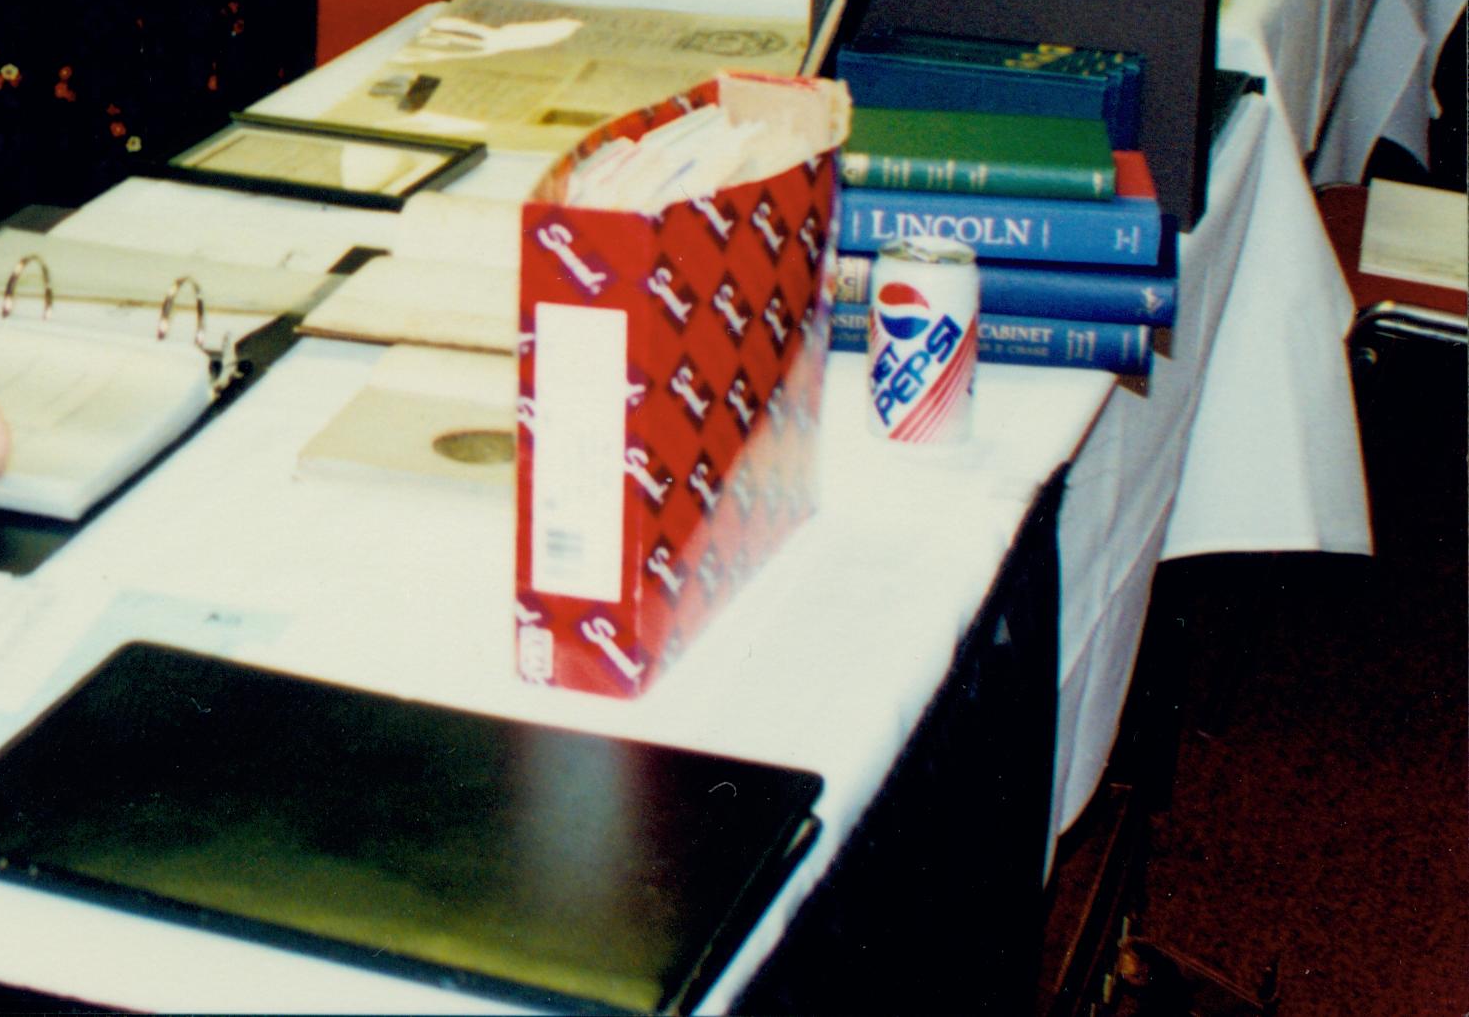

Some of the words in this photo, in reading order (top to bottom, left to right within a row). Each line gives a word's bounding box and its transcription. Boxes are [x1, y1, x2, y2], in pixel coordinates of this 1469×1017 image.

[871, 210, 1031, 245] LINCOLN
[978, 324, 1052, 343] CABINET
[874, 313, 963, 426] PEPSI
